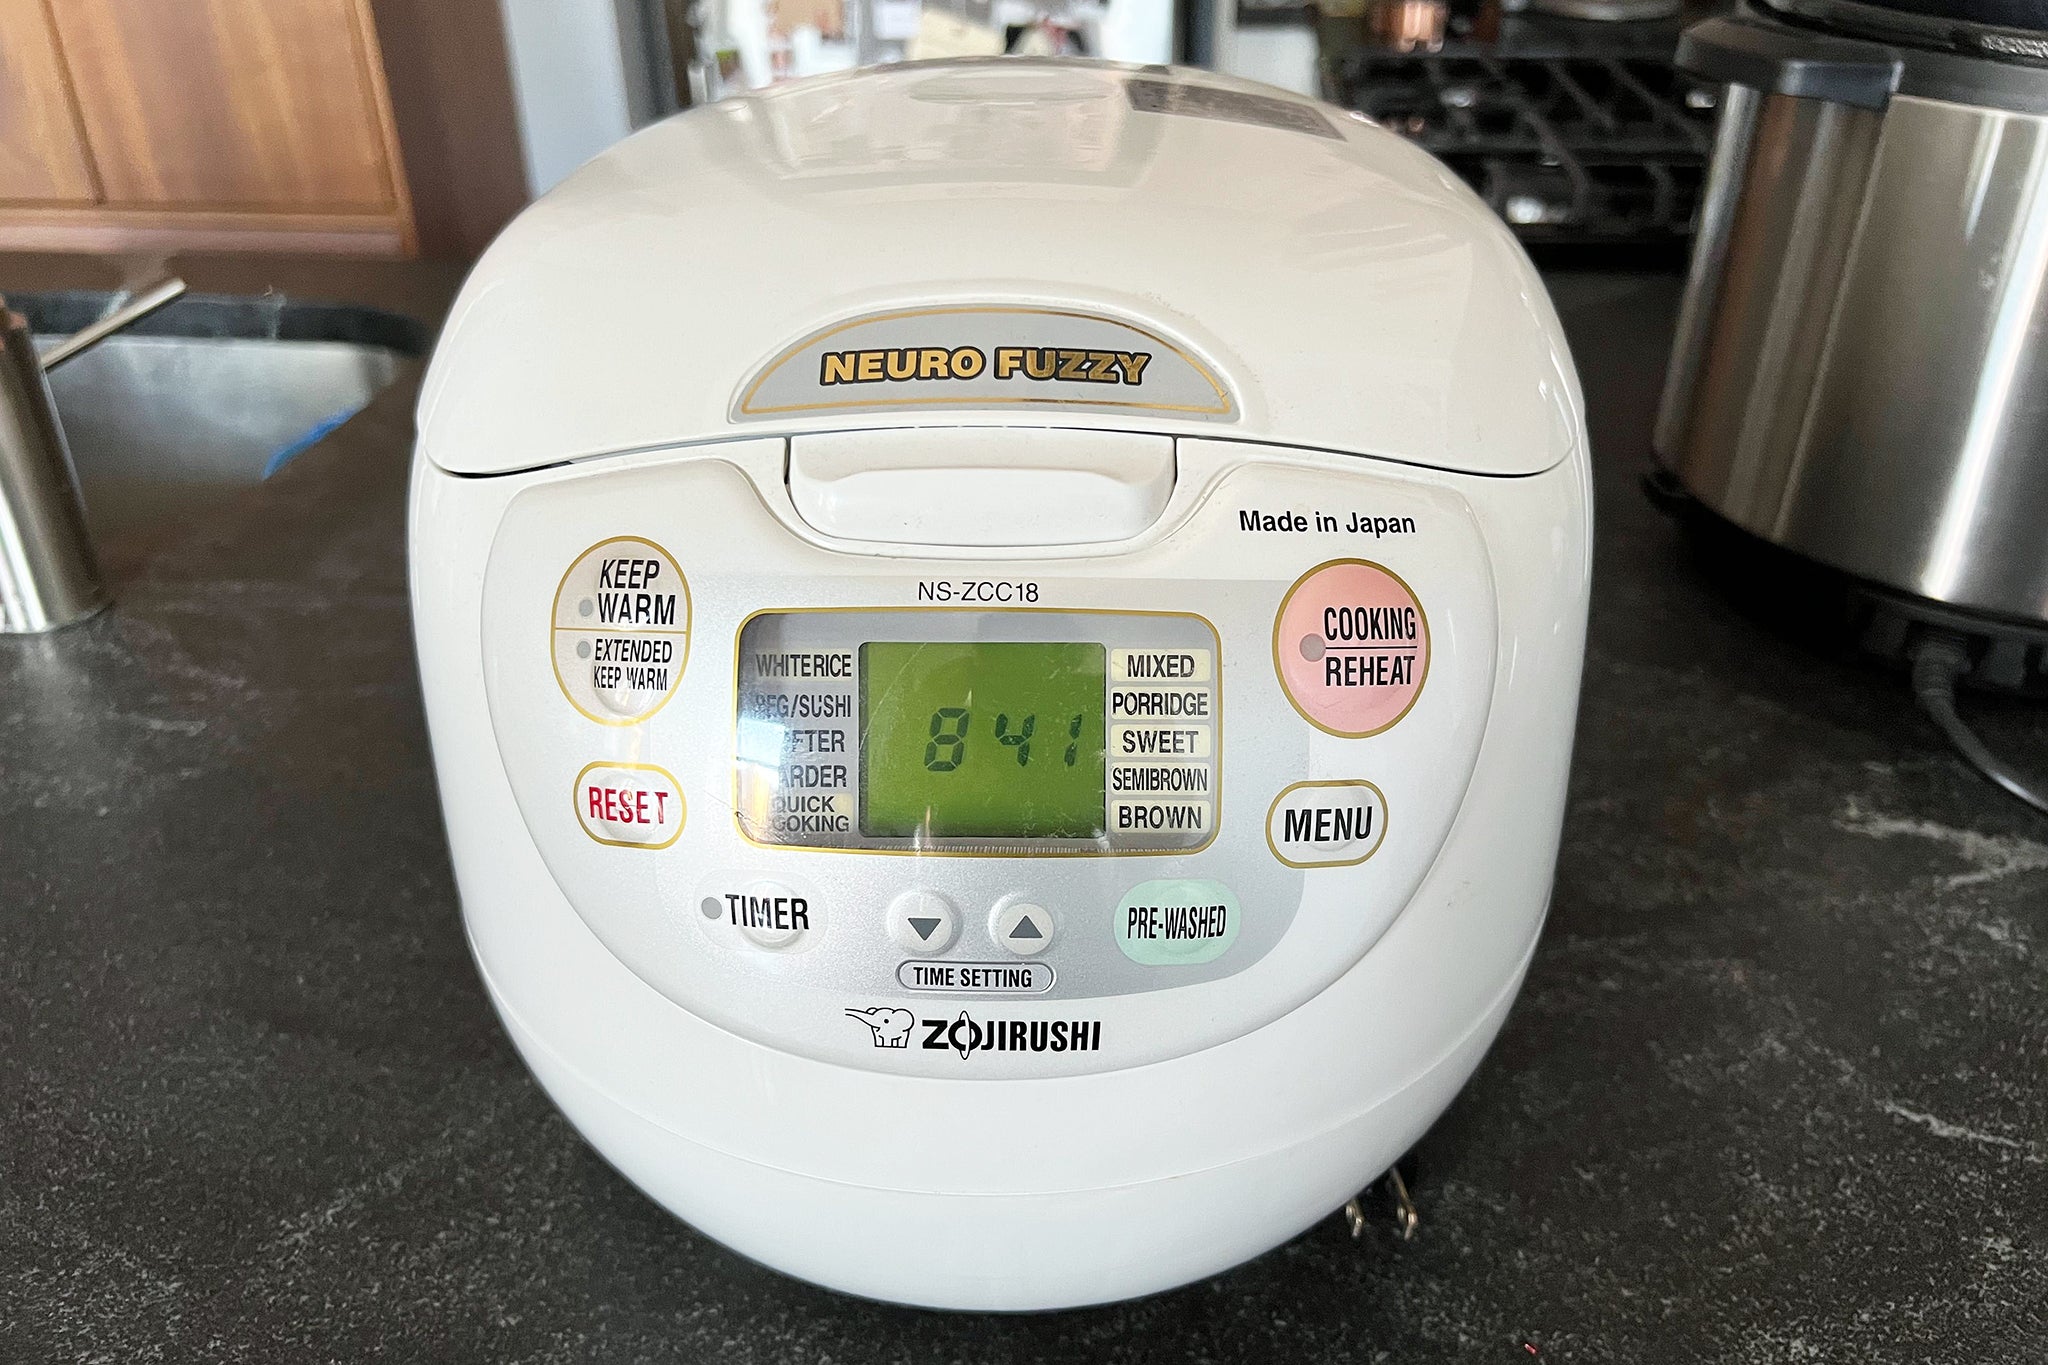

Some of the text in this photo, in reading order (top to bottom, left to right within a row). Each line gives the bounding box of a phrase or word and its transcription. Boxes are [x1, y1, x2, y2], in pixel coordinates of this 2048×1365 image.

[820, 345, 1152, 386] NEURO FUZZY
[1239, 510, 1416, 538] Made in Japan
[600, 559, 660, 589] KEEP
[918, 581, 1039, 603] NS-ZCC18
[597, 593, 676, 625] WARM
[1324, 606, 1417, 640] COOKING
[594, 638, 673, 664] EXTENDED
[593, 665, 668, 691] KEEP WARM
[1127, 654, 1195, 678] MIXED
[1325, 655, 1416, 687] REHEAT
[1112, 692, 1208, 717] PORRIDGE
[775, 729, 845, 752] FTER
[1122, 730, 1199, 754] SWEET
[772, 765, 847, 788] ARDER
[1112, 768, 1208, 792] SEMIBROWN
[588, 786, 668, 824] RESET
[773, 796, 835, 813] QUICK
[1118, 806, 1202, 829] BROWN
[1284, 806, 1373, 842] MENU
[725, 893, 810, 931] TIMER
[1127, 905, 1227, 940] PRE-WASHED
[913, 967, 1032, 989] TIME SETTING
[922, 1011, 1101, 1060] ZOJIRUSHI
